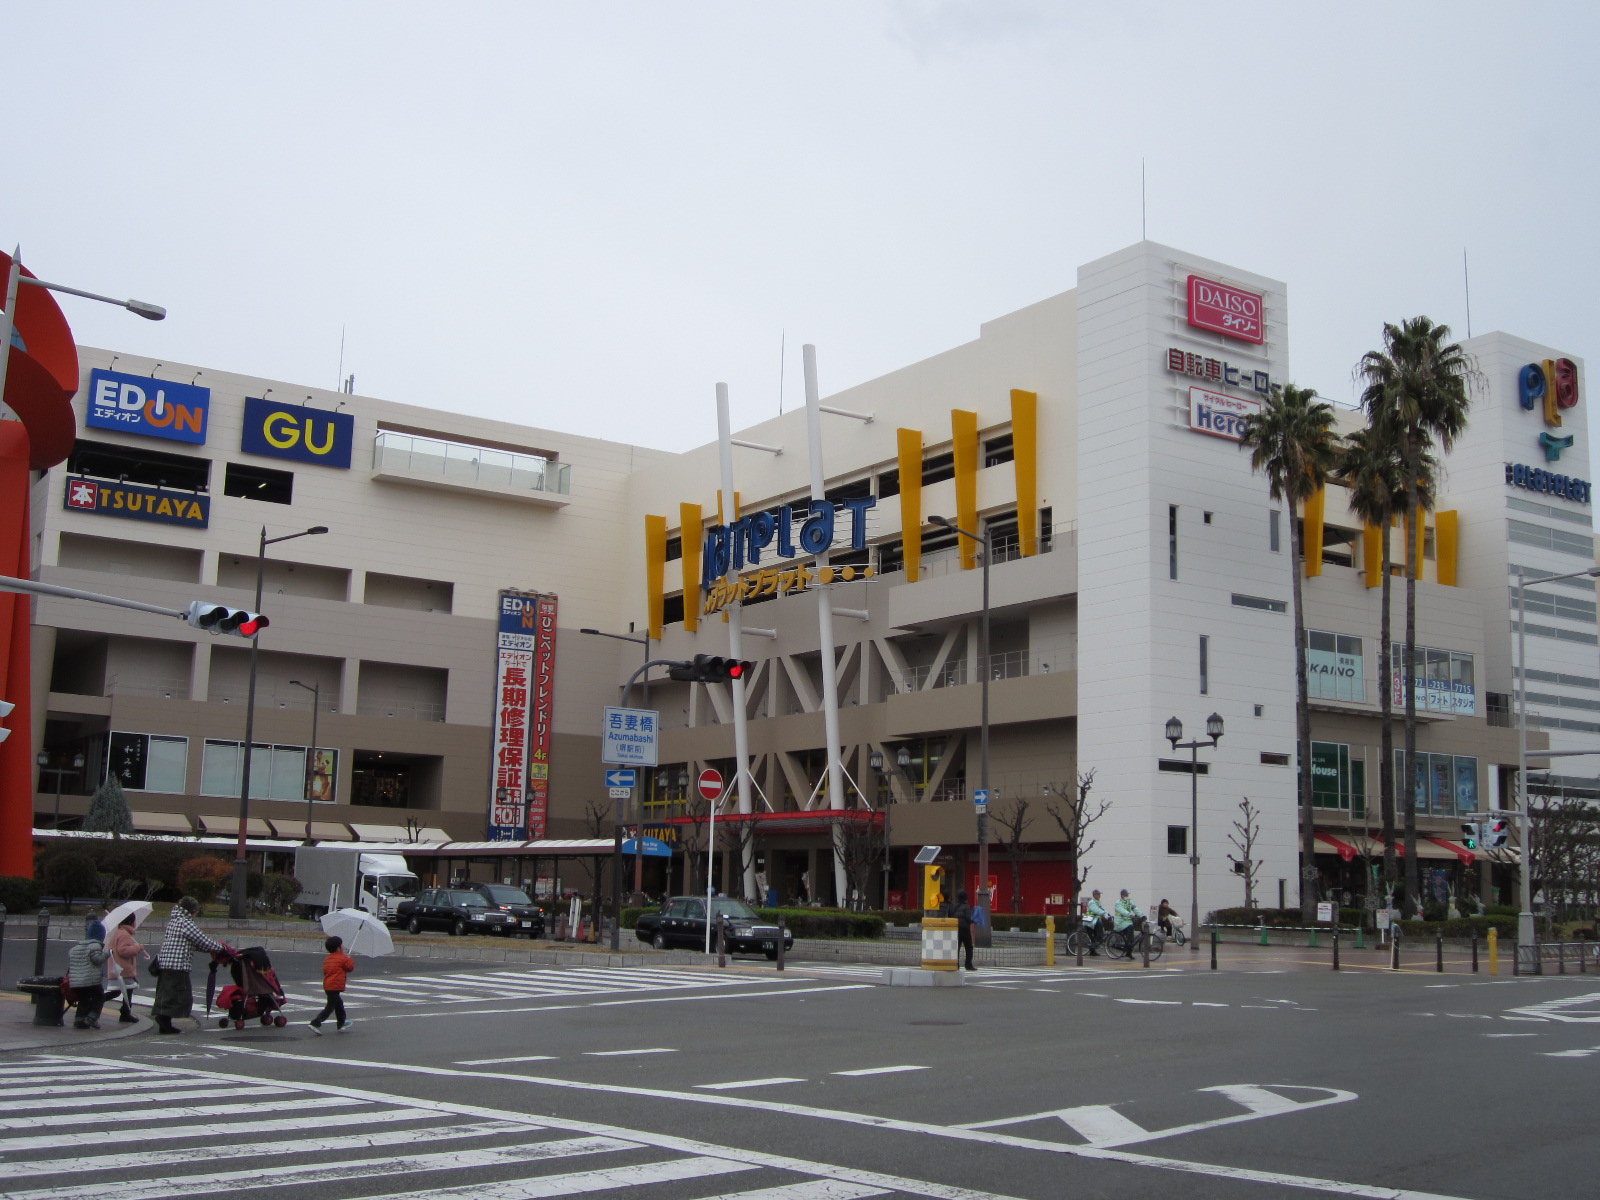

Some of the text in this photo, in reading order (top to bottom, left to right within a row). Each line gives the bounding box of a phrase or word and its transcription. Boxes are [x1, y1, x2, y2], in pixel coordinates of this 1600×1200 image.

[1199, 285, 1256, 316] DAISO
[1222, 314, 1257, 331] ダイソー
[1168, 348, 1282, 394] 自転車ヒーロー
[94, 408, 141, 422] エディオン
[95, 379, 203, 433] EDION
[1197, 403, 1248, 435] Hero
[263, 411, 335, 455] GU
[72, 484, 203, 520] 本 TSUTAYA
[501, 640, 532, 649] エディオン
[500, 652, 532, 661] エディオン
[1310, 663, 1355, 677] KAINO
[497, 668, 527, 789] 長期修理保証
[610, 713, 654, 732] 吾妻橋
[608, 731, 654, 744] Azumabashi
[534, 749, 547, 760] 4F
[643, 828, 677, 842] SUTAYA
